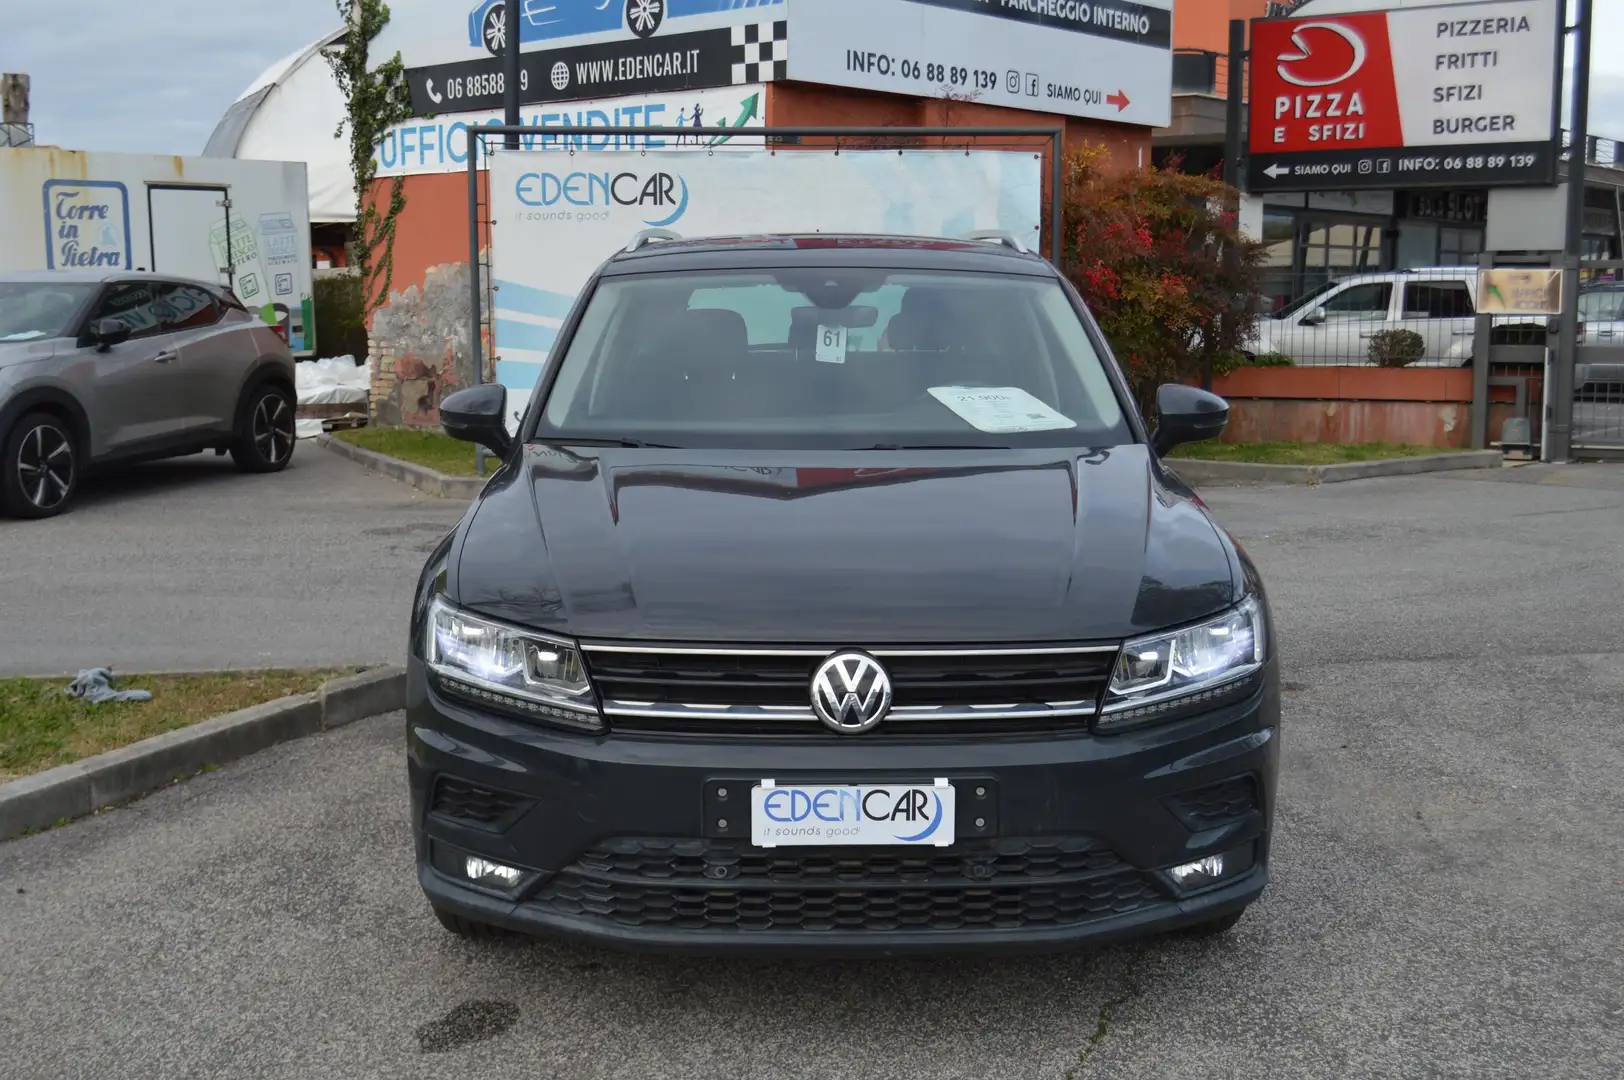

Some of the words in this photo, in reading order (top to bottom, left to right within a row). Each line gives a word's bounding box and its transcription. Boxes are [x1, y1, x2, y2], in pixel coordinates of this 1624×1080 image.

[1093, 6, 1150, 35] INTERNO
[1436, 15, 1530, 38] PIZZERIA
[575, 49, 700, 85] WWW.EDENCAR.IT
[846, 49, 896, 77] INFO:
[901, 59, 921, 80] 06
[926, 62, 945, 83] 88
[949, 66, 968, 86] 89
[973, 69, 997, 90] 139
[1435, 51, 1498, 70] FRITTI
[447, 78, 463, 99] 06
[1046, 82, 1081, 102] SIAMO
[1083, 88, 1101, 105] QUI
[1432, 84, 1482, 103] SFIZI
[1274, 91, 1364, 120] PIZZA
[519, 103, 666, 151] VENDITE
[1273, 126, 1286, 143] E
[1308, 122, 1365, 142] SFIZI
[1432, 114, 1515, 135] BURGER
[1294, 163, 1329, 175] SIAMO
[1331, 163, 1352, 175] QUI
[1398, 157, 1440, 171] INFO:
[1443, 156, 1461, 170] 06
[1465, 155, 1483, 169] 88
[1487, 154, 1505, 168] 89
[1509, 153, 1534, 168] 139
[515, 171, 677, 206] EDENCAR
[56, 191, 109, 220] Torre
[526, 210, 573, 221] sounds
[58, 220, 79, 239] in
[60, 239, 121, 267] Pietra
[823, 330, 841, 348] 61
[763, 789, 929, 822] EDENCAR
[775, 826, 821, 836] sounds
